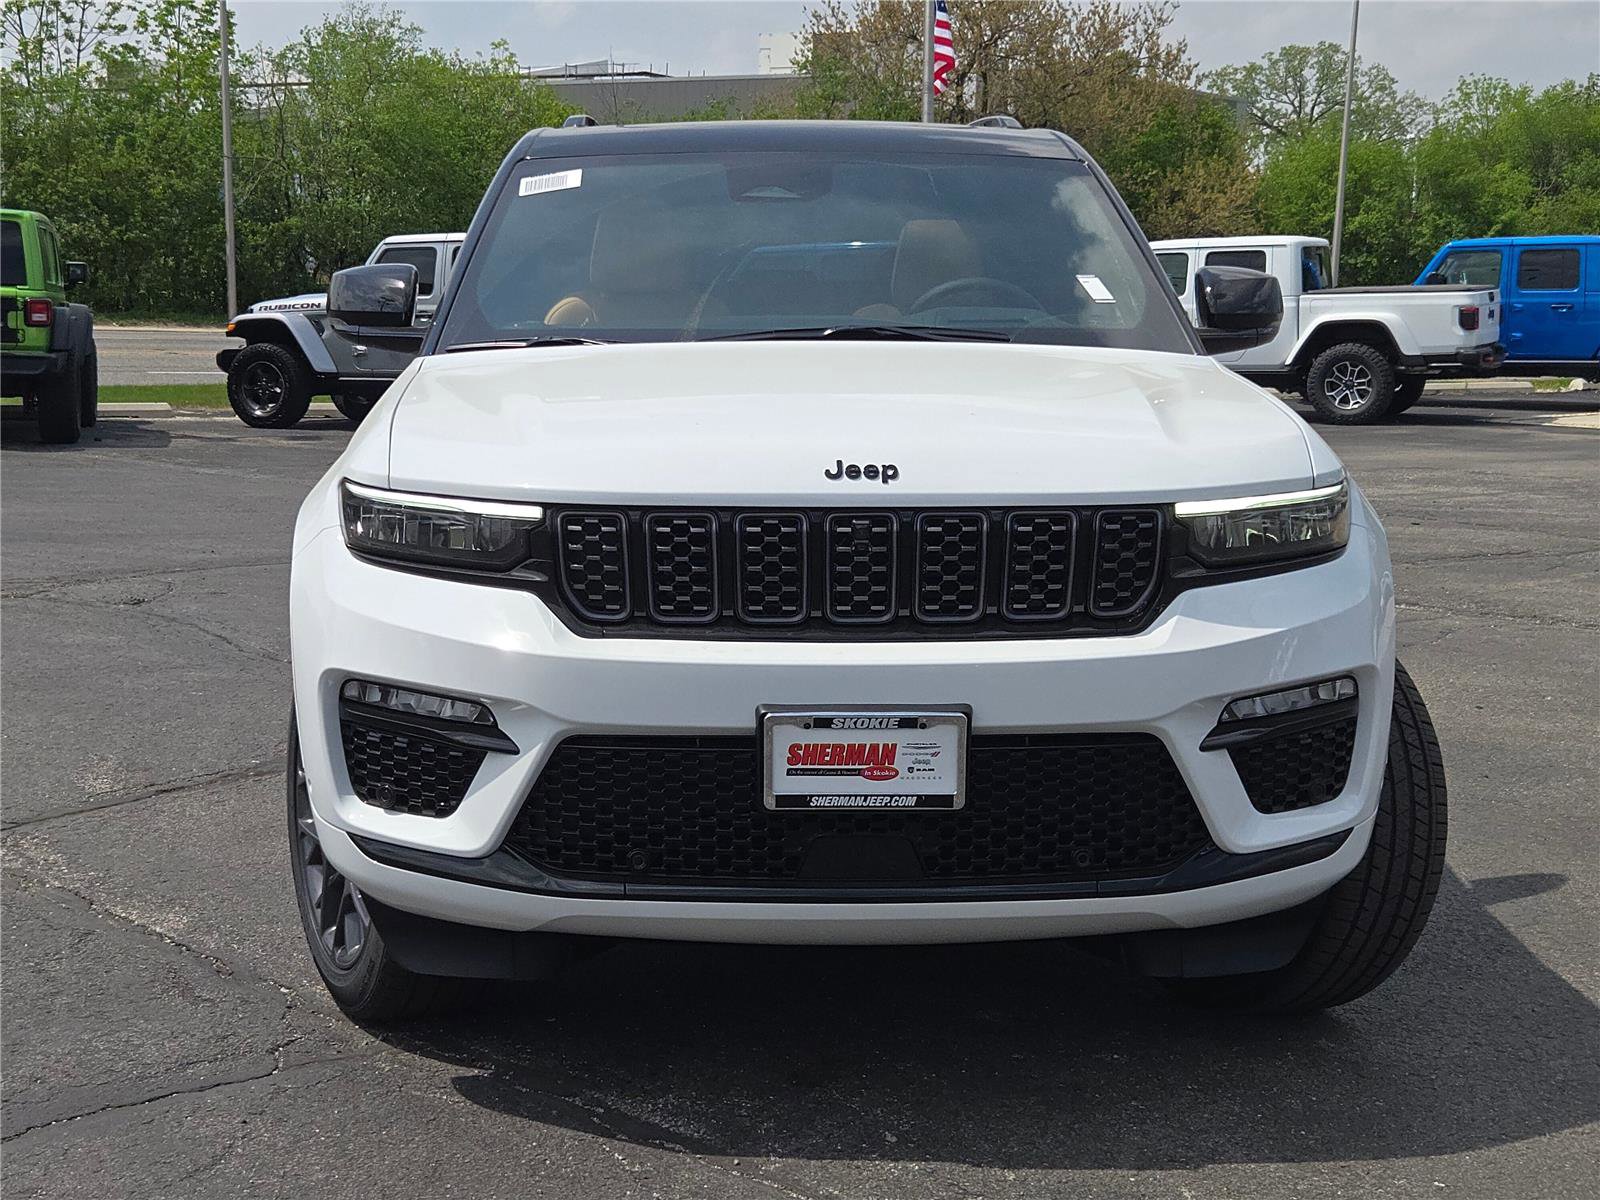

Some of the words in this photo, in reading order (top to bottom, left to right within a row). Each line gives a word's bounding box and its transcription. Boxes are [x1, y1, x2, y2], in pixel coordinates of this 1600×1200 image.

[259, 302, 321, 311] RUBICON
[824, 459, 899, 485] Jeep
[831, 718, 900, 729] SKOKIE
[786, 743, 898, 766] SHERMAN
[810, 796, 917, 806] SHERMANJEEP.COM
